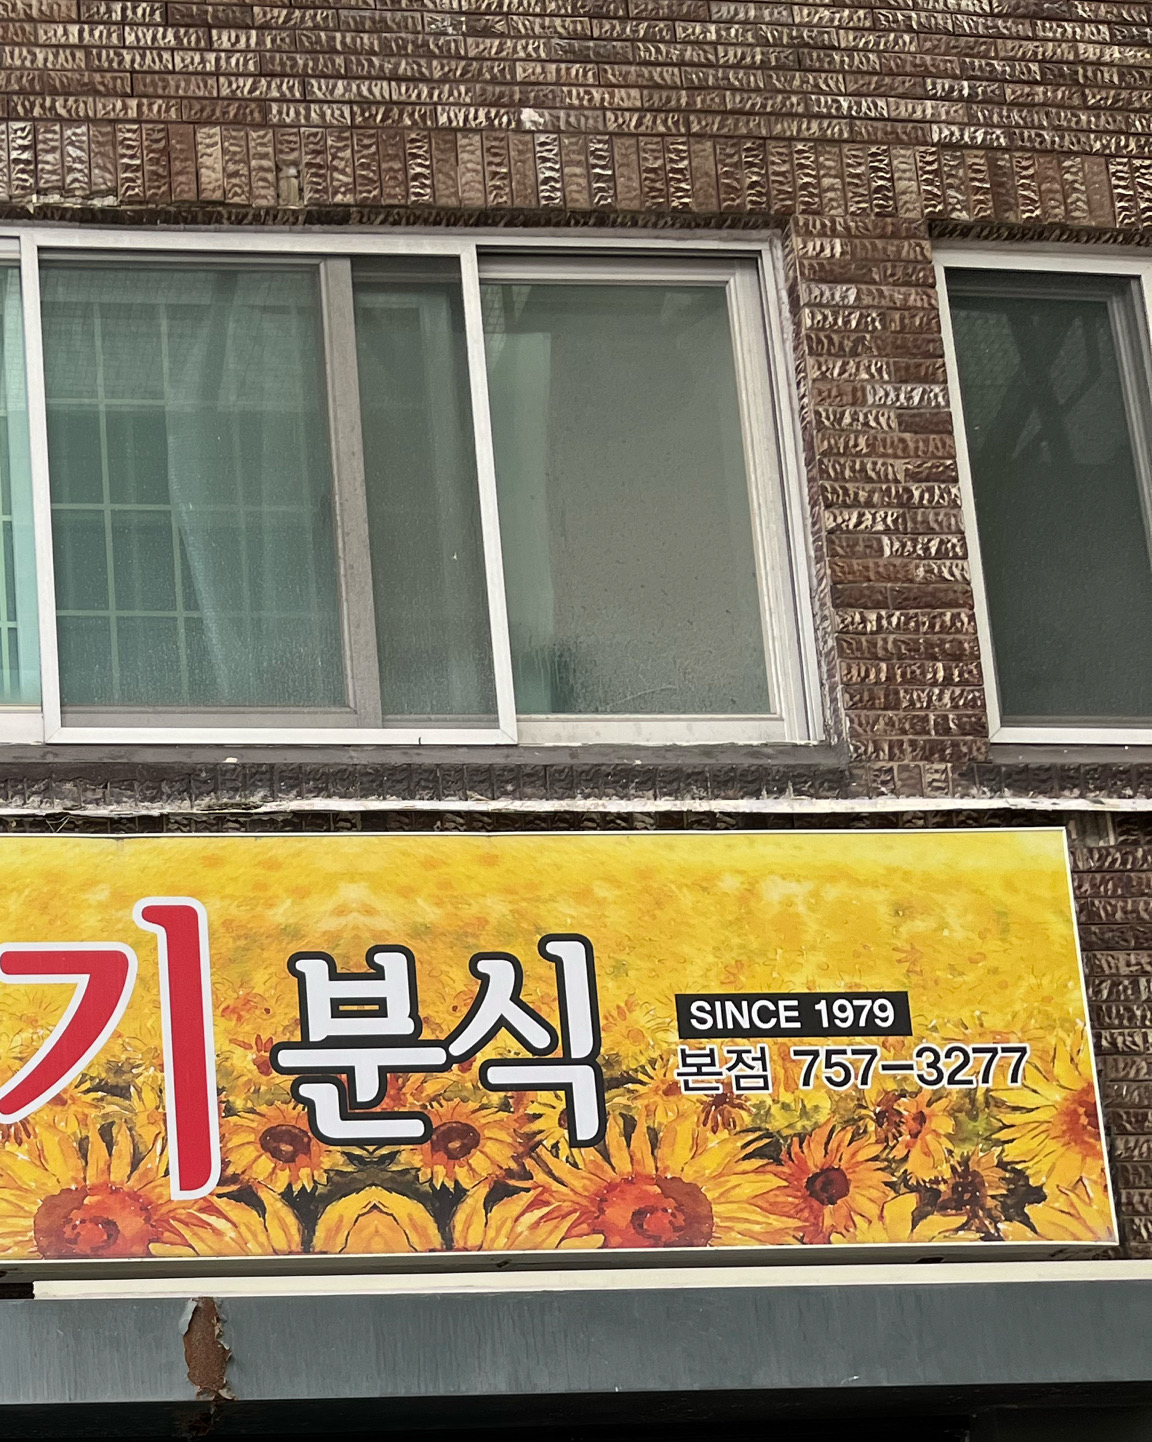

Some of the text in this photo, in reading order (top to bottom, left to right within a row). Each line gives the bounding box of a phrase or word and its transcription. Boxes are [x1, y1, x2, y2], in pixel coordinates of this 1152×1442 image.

[270, 932, 607, 1147] 분식
[689, 997, 896, 1031] SINCE 1979
[674, 1042, 1030, 1094] 본점 757-3277
